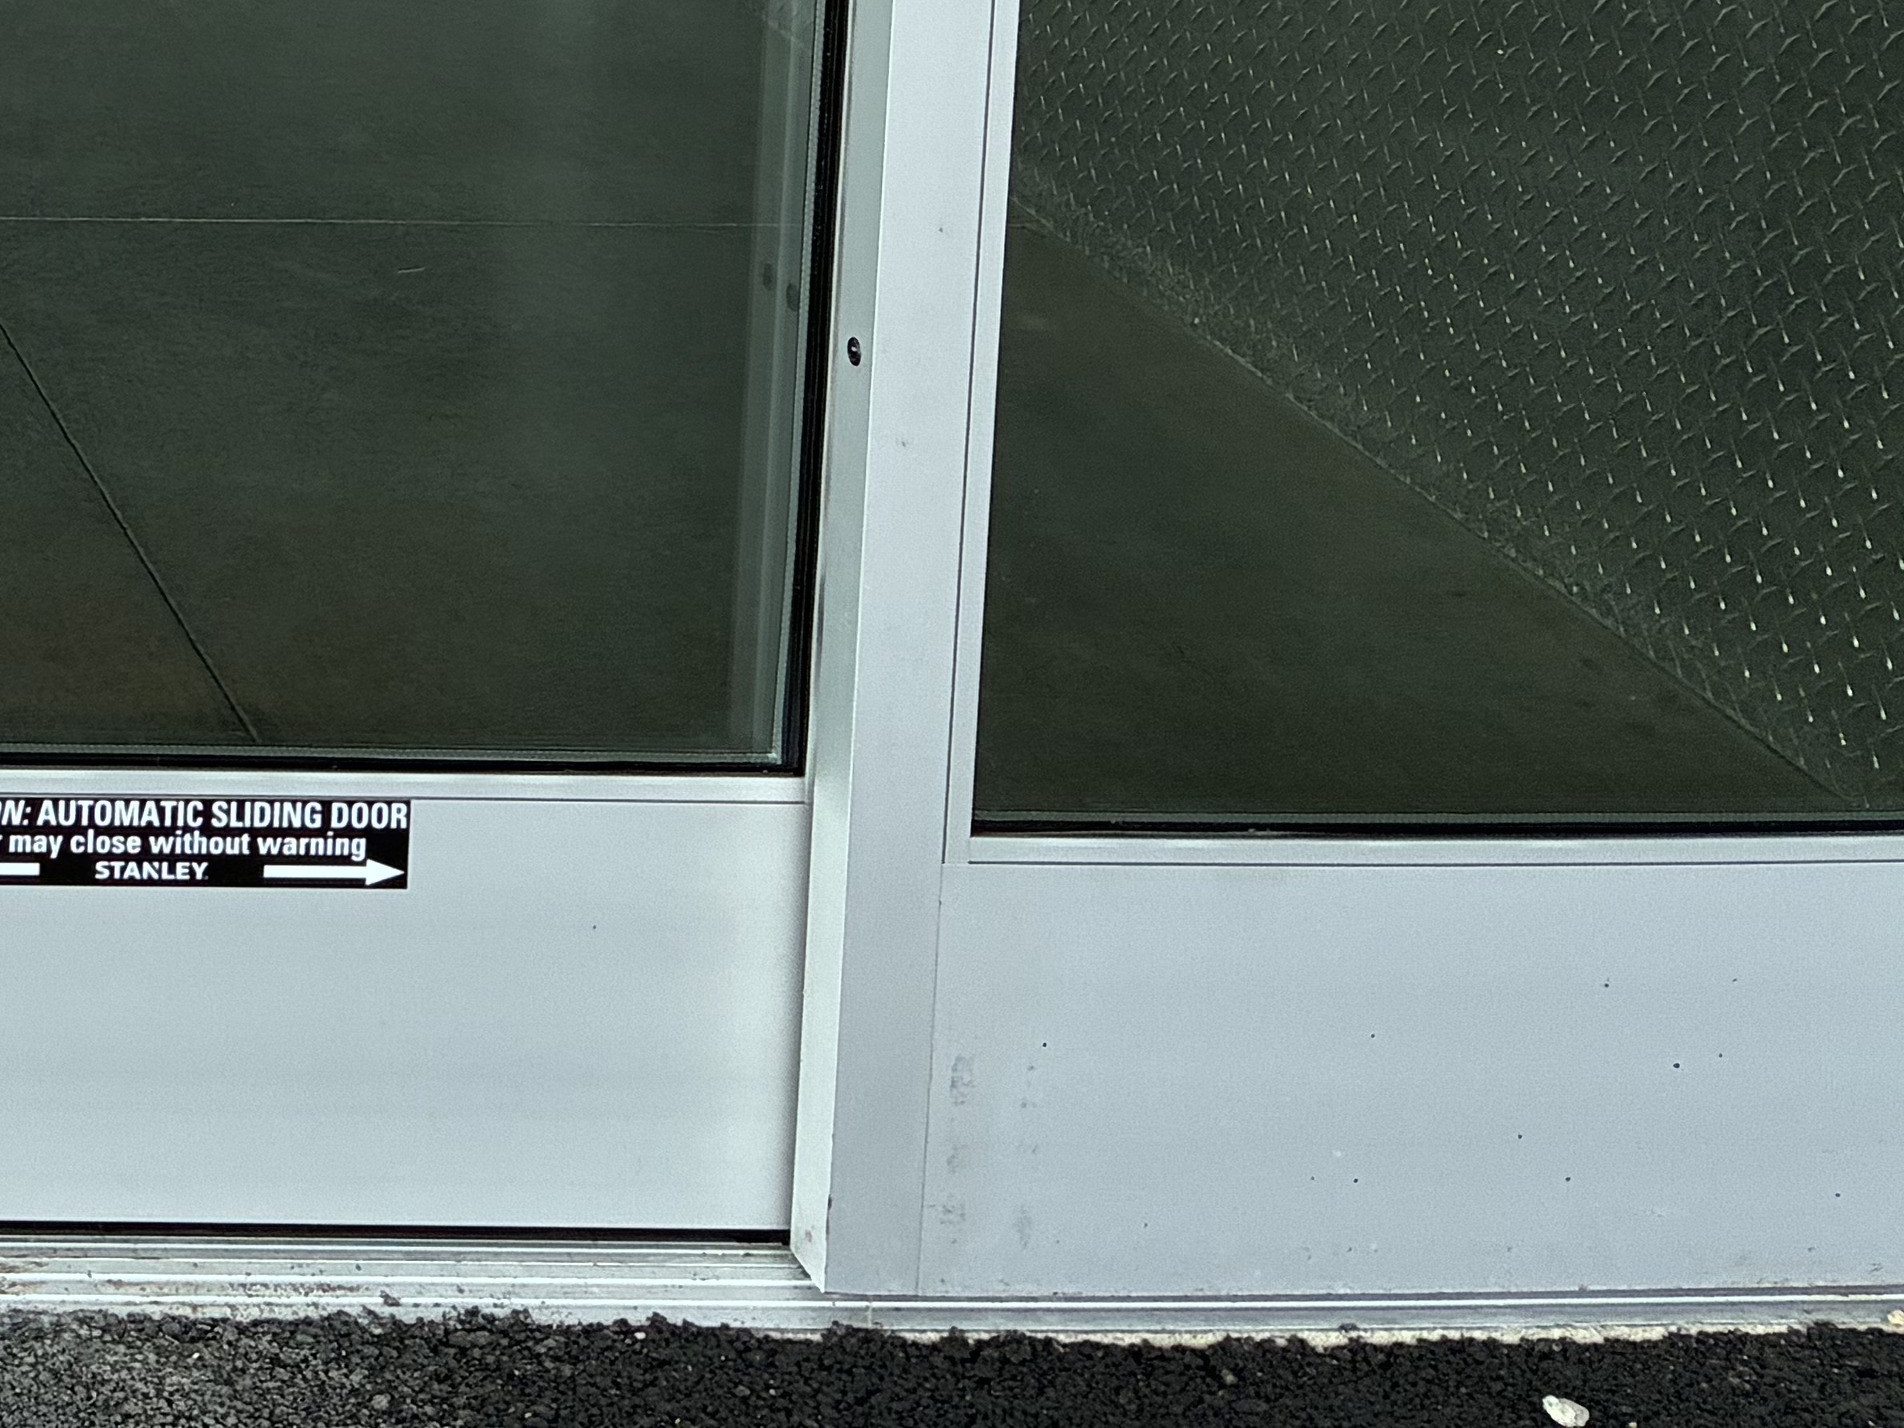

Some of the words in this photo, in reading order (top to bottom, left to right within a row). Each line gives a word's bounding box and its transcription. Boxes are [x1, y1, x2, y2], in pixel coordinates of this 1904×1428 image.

[35, 799, 205, 828] AUTOMATIC
[209, 800, 323, 828] SLIDING
[330, 802, 408, 828] DOOR
[8, 832, 64, 858] may
[70, 830, 144, 854] close
[150, 830, 253, 855] without
[257, 832, 368, 860] warning
[96, 860, 211, 880] STANLEY
